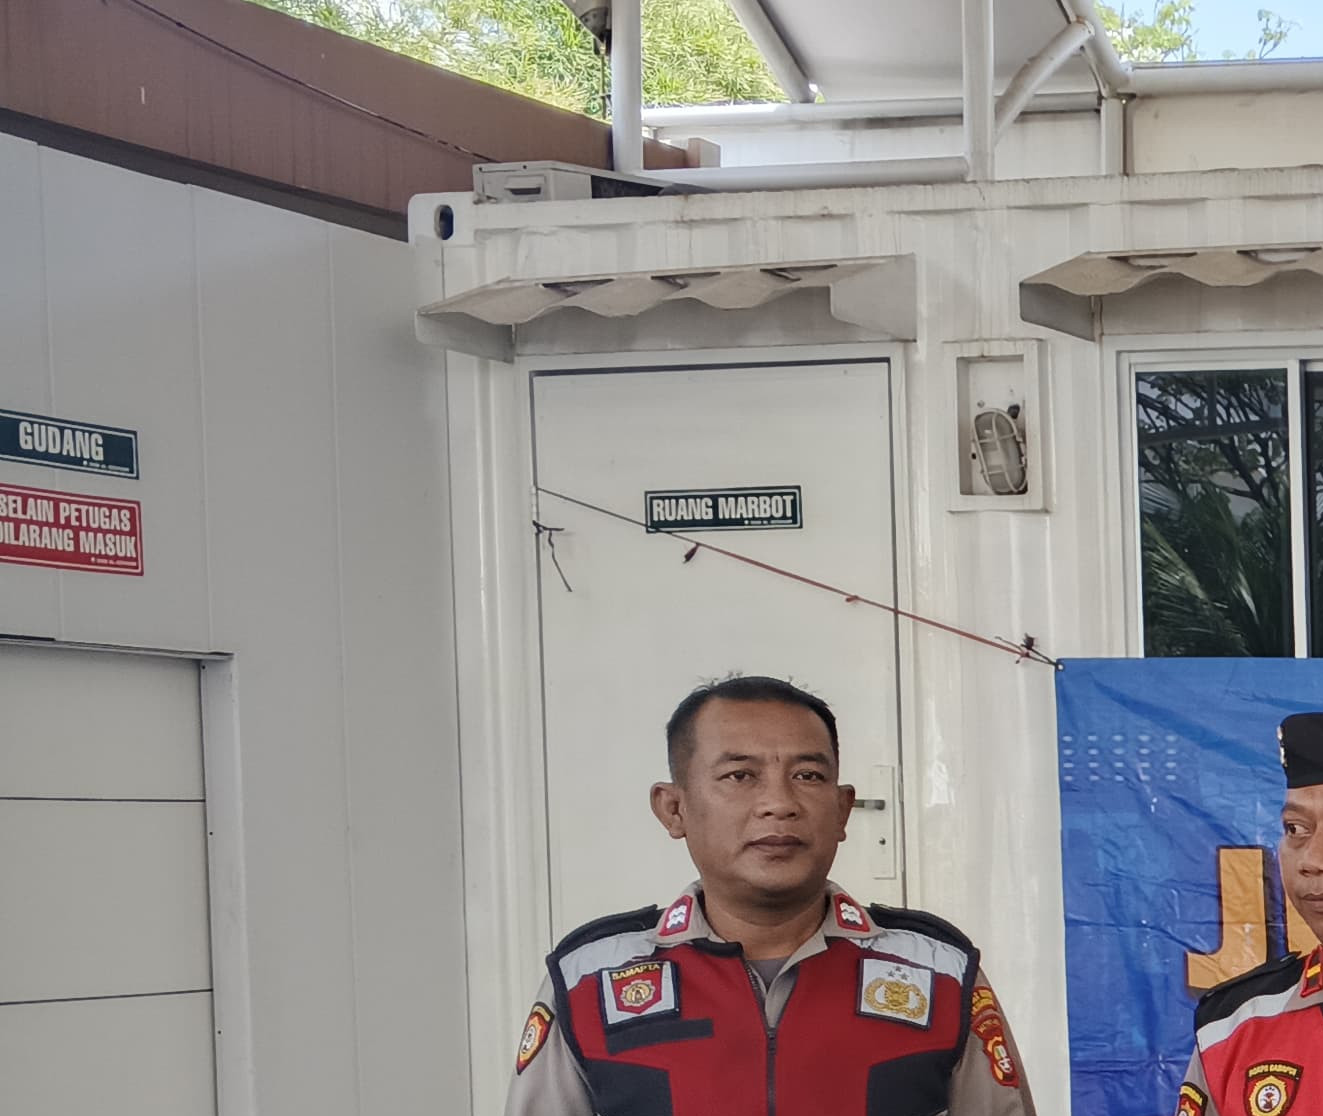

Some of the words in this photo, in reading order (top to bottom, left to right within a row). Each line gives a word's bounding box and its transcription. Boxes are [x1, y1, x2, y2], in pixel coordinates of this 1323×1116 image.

[19, 421, 104, 461] GUDANG
[0, 493, 54, 523] SELAIN
[59, 502, 131, 532] PETUGAS
[652, 497, 714, 521] RUANG
[718, 495, 794, 520] MARBOT
[79, 531, 137, 558] MASUK
